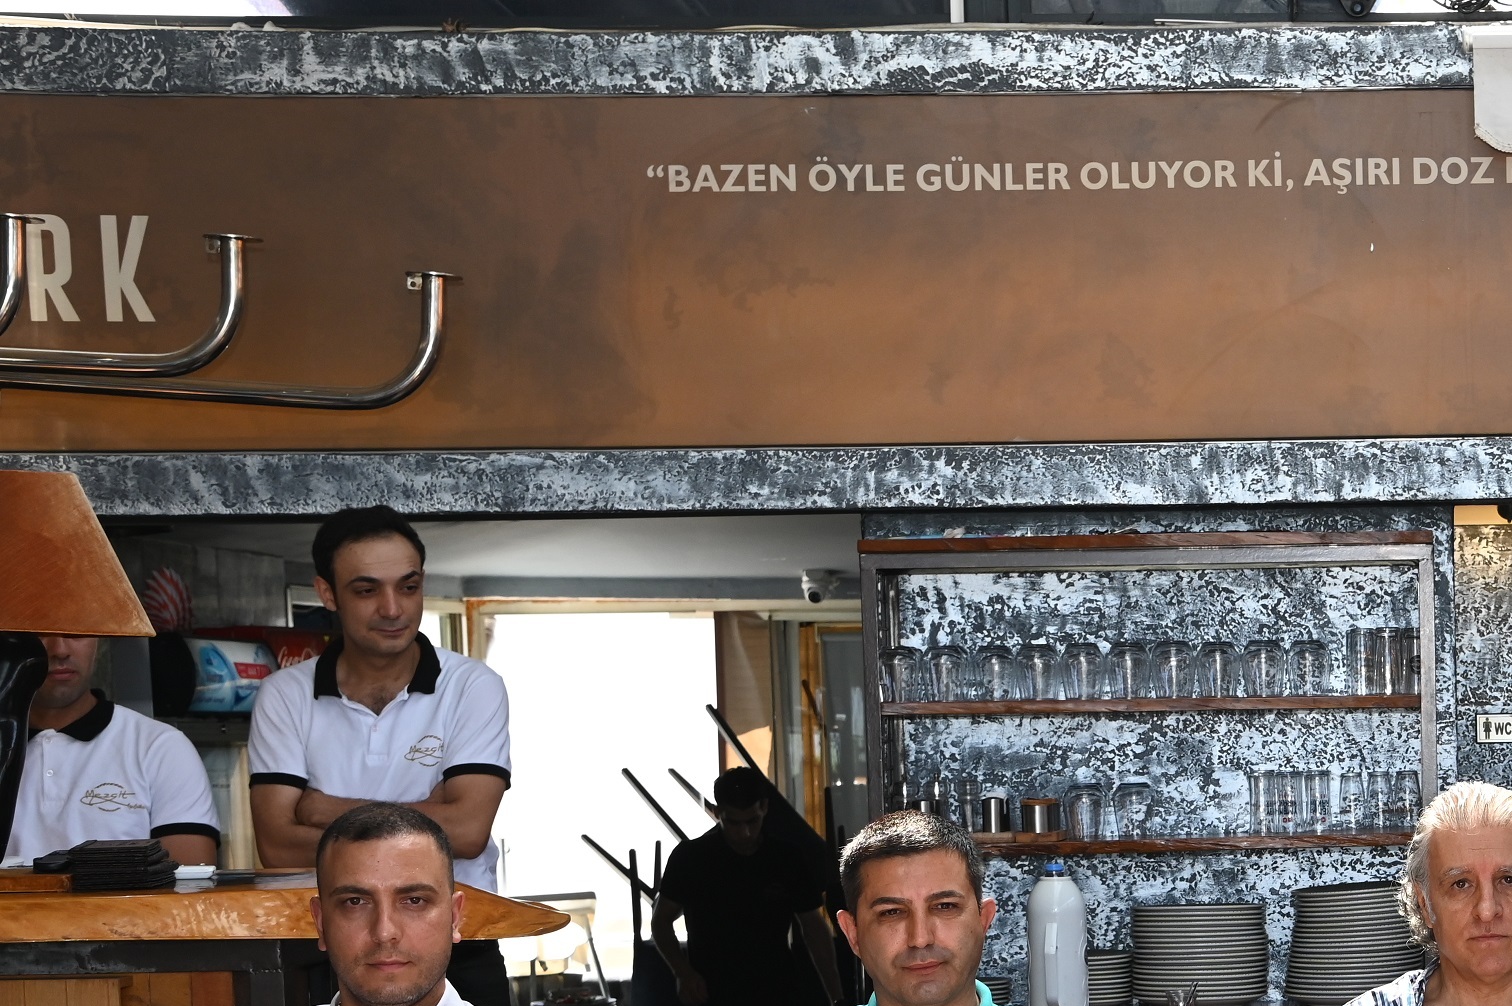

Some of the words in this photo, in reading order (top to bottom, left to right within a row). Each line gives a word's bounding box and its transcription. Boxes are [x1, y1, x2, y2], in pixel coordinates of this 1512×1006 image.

[647, 164, 797, 193] “BAZEN
[809, 156, 905, 192] ÖYLE
[916, 156, 1071, 192] GÜNLER
[1080, 160, 1238, 190] OLUYOR
[1248, 151, 1294, 192] Kİ,
[1303, 157, 1400, 195] AŞIRI
[1413, 156, 1495, 185] DOZ
[1494, 722, 1512, 736] WC
